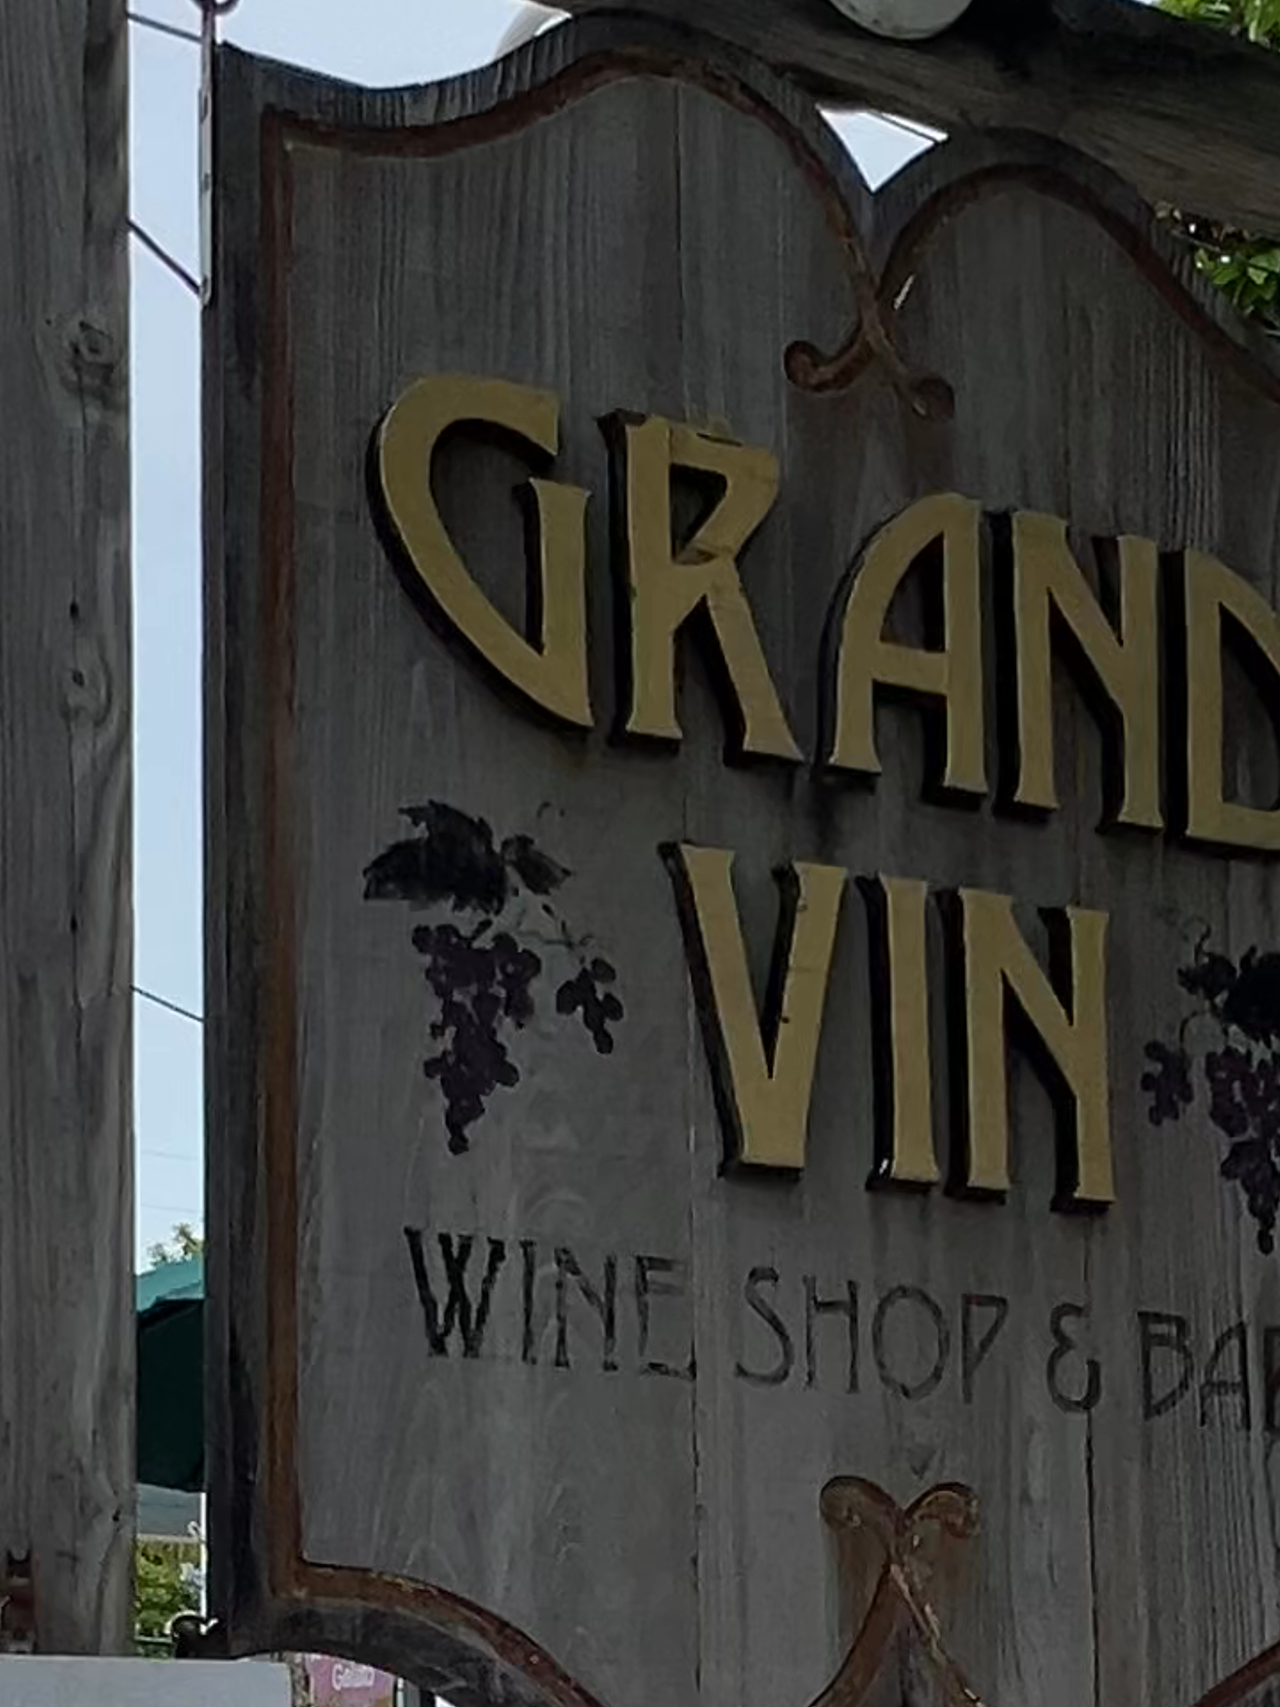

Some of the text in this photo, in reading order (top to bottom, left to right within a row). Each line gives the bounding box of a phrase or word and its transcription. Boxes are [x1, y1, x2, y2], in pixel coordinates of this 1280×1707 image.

[658, 841, 1116, 1213] VIN
[403, 1225, 698, 1383] WINE
[734, 1265, 1010, 1405] SHOP
[1045, 1302, 1102, 1415] &
